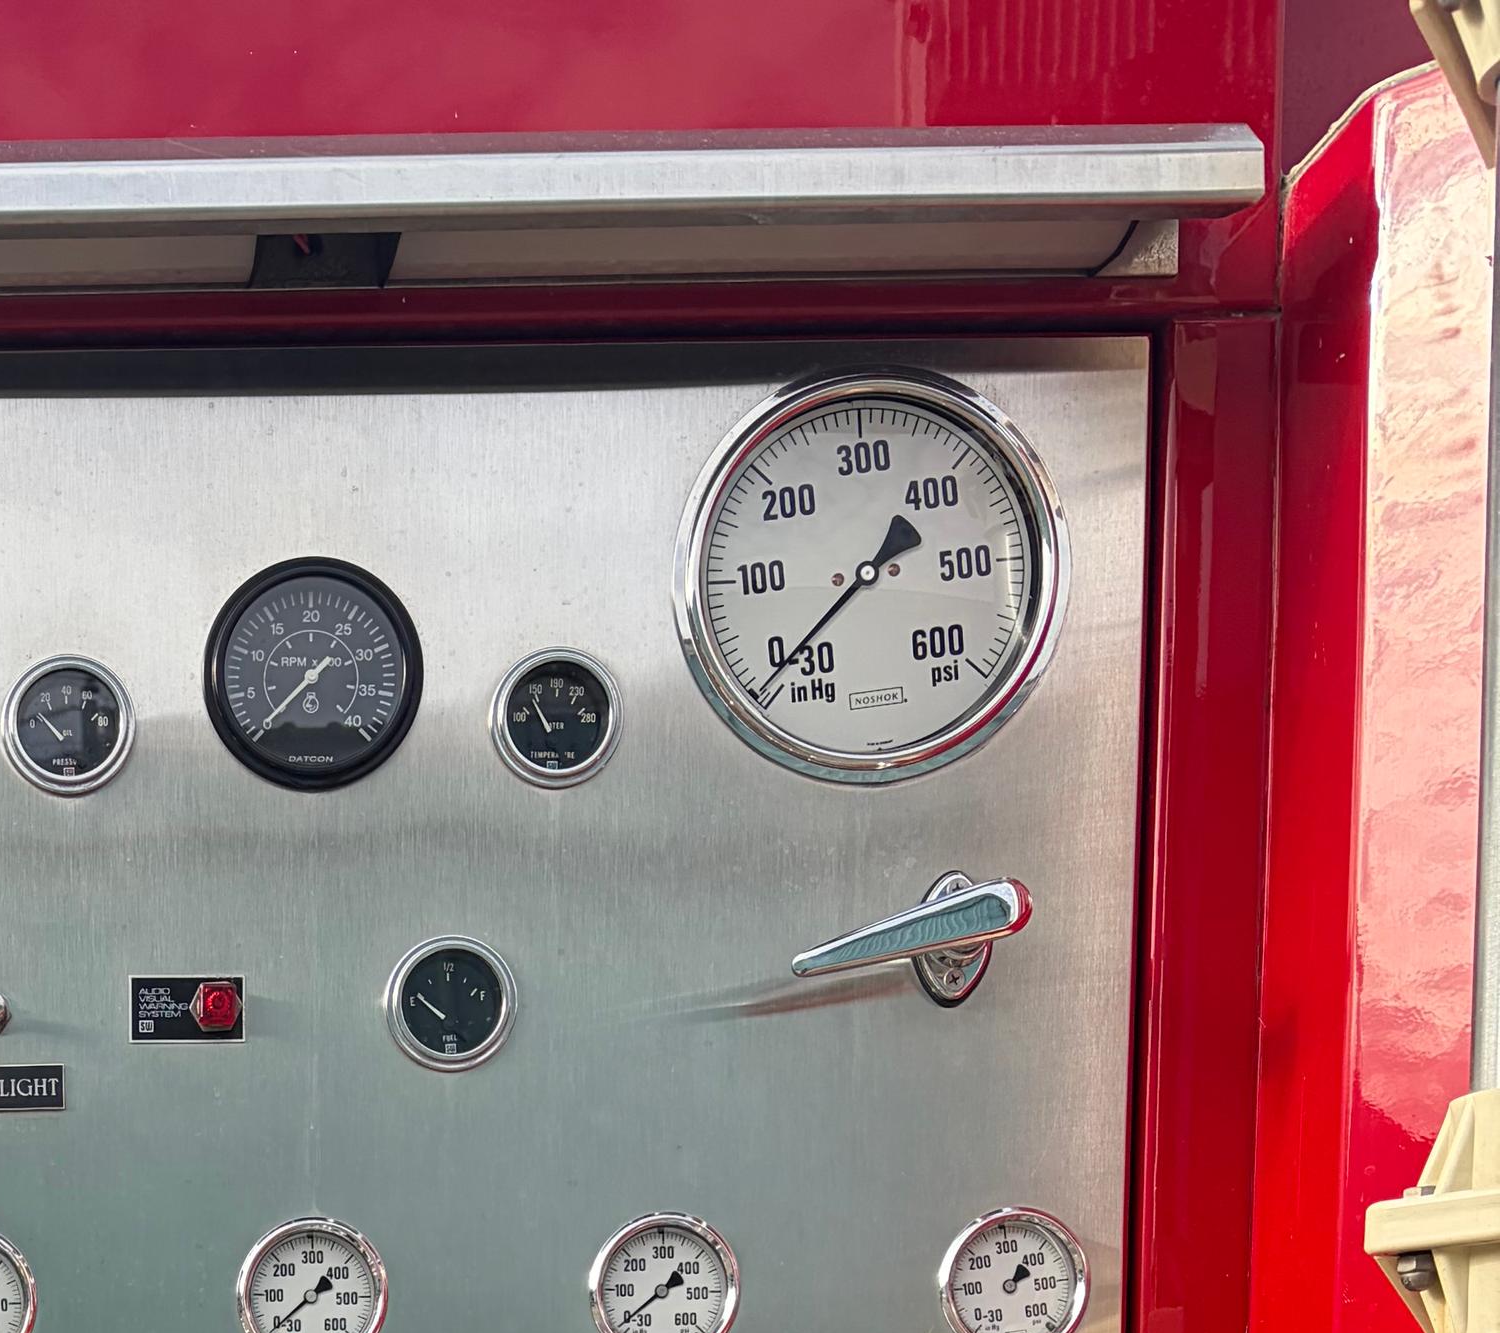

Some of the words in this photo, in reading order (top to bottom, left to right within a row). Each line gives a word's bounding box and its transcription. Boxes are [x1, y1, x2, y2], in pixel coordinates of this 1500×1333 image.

[837, 439, 891, 476] 300
[906, 475, 959, 510] 400
[762, 483, 816, 521] 200
[939, 544, 991, 581] 500
[737, 560, 785, 595] 100
[302, 610, 320, 623] 20
[912, 624, 964, 660] 600
[250, 649, 265, 662] 10
[355, 649, 373, 661] 30
[932, 660, 959, 687] psi
[855, 692, 899, 705] NOSHOK
[344, 715, 362, 727] 40
[288, 755, 333, 763] DATCON
[139, 987, 169, 995] AUDIO
[139, 995, 173, 1003] VISUAL
[139, 1003, 189, 1011] WARNING
[139, 1010, 181, 1018] SYSTEM
[0, 1078, 59, 1098] LIGHT
